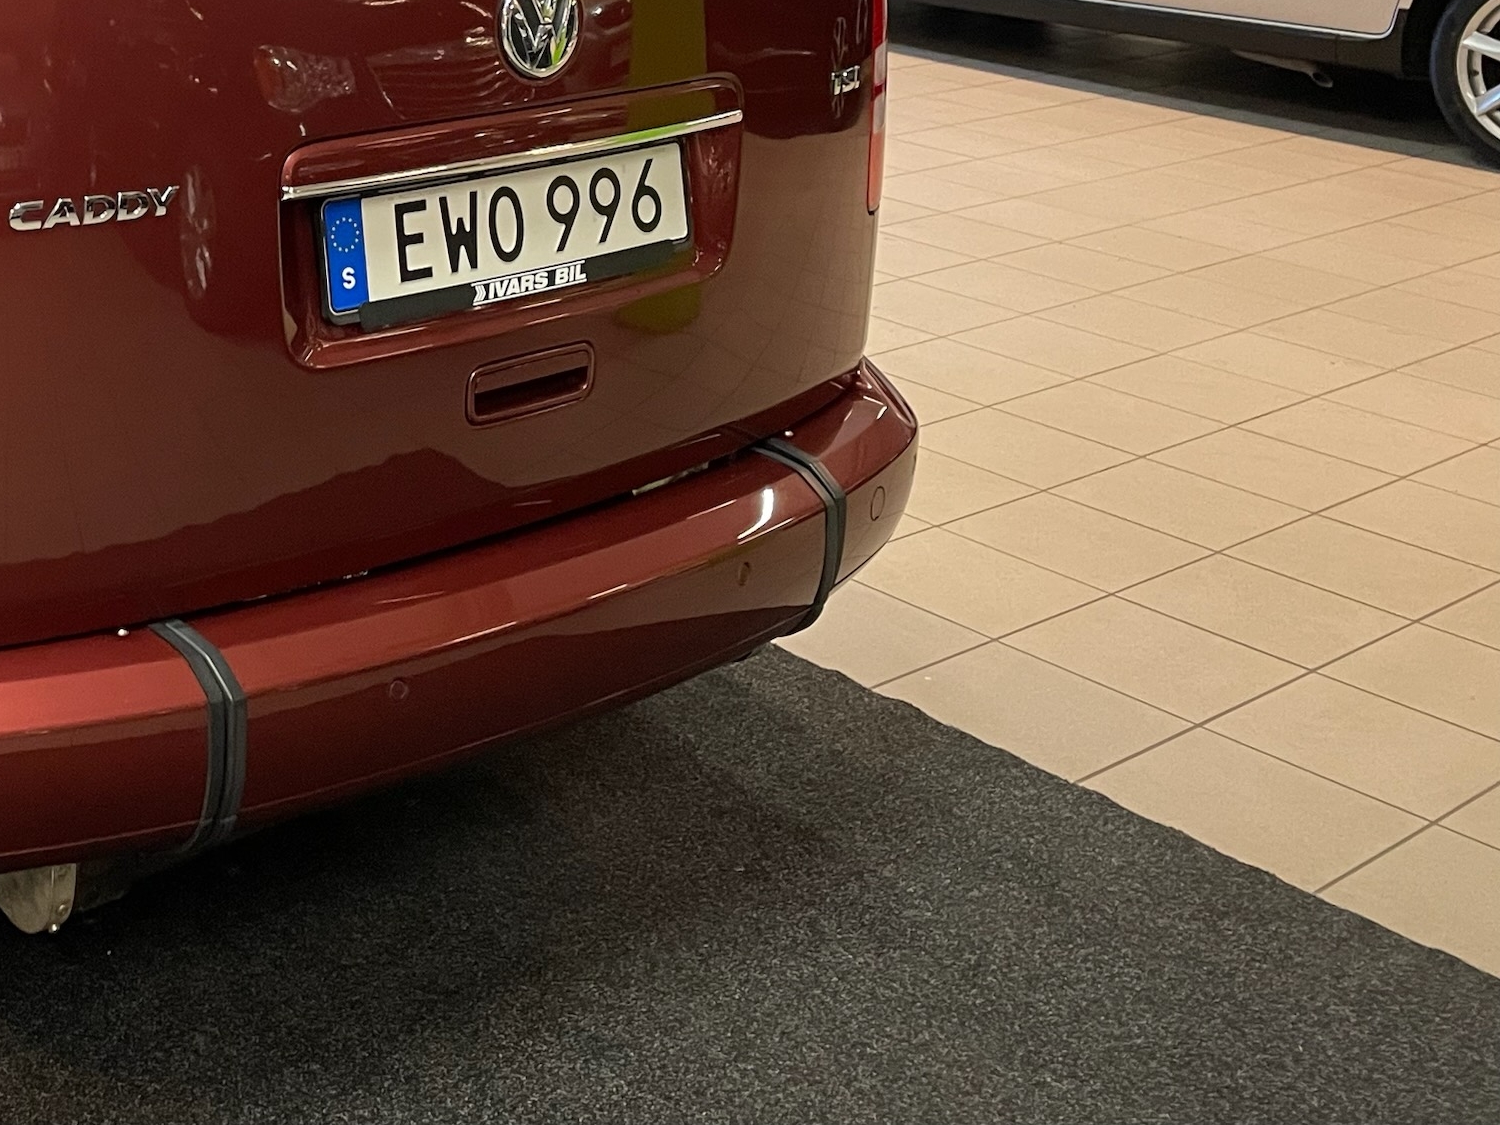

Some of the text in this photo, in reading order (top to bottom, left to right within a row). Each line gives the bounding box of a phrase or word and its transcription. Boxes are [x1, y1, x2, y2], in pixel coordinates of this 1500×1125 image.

[9, 185, 180, 231] CADDY
[393, 157, 663, 284] EWO 996
[341, 266, 357, 289] S
[487, 261, 587, 301] IVARS BIL
